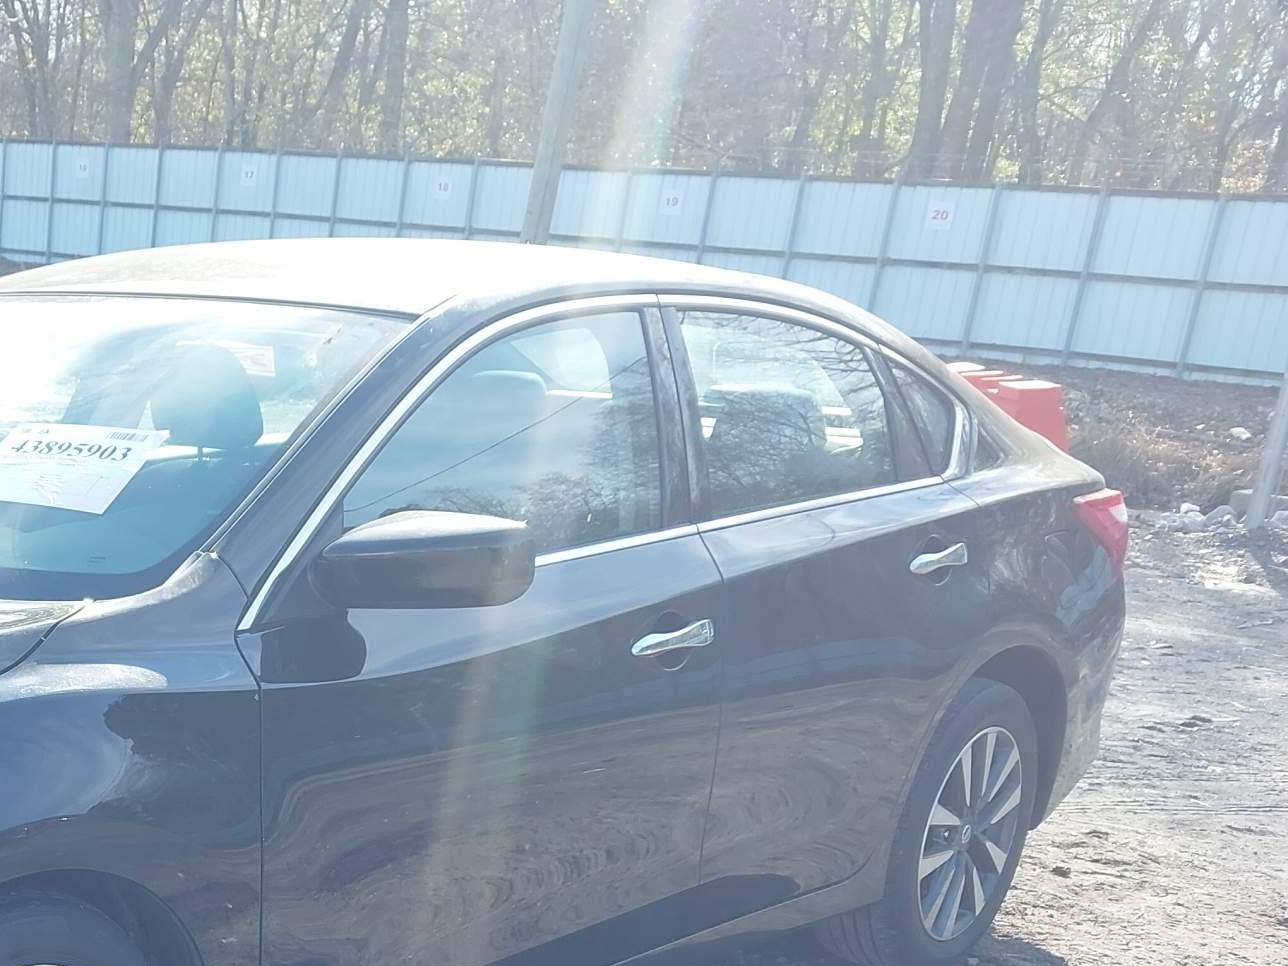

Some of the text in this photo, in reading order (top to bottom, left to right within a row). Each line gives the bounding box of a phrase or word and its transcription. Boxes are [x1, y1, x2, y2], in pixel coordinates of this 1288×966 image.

[666, 196, 679, 206] 19
[931, 209, 949, 221] 20
[11, 439, 133, 461] 43895903
